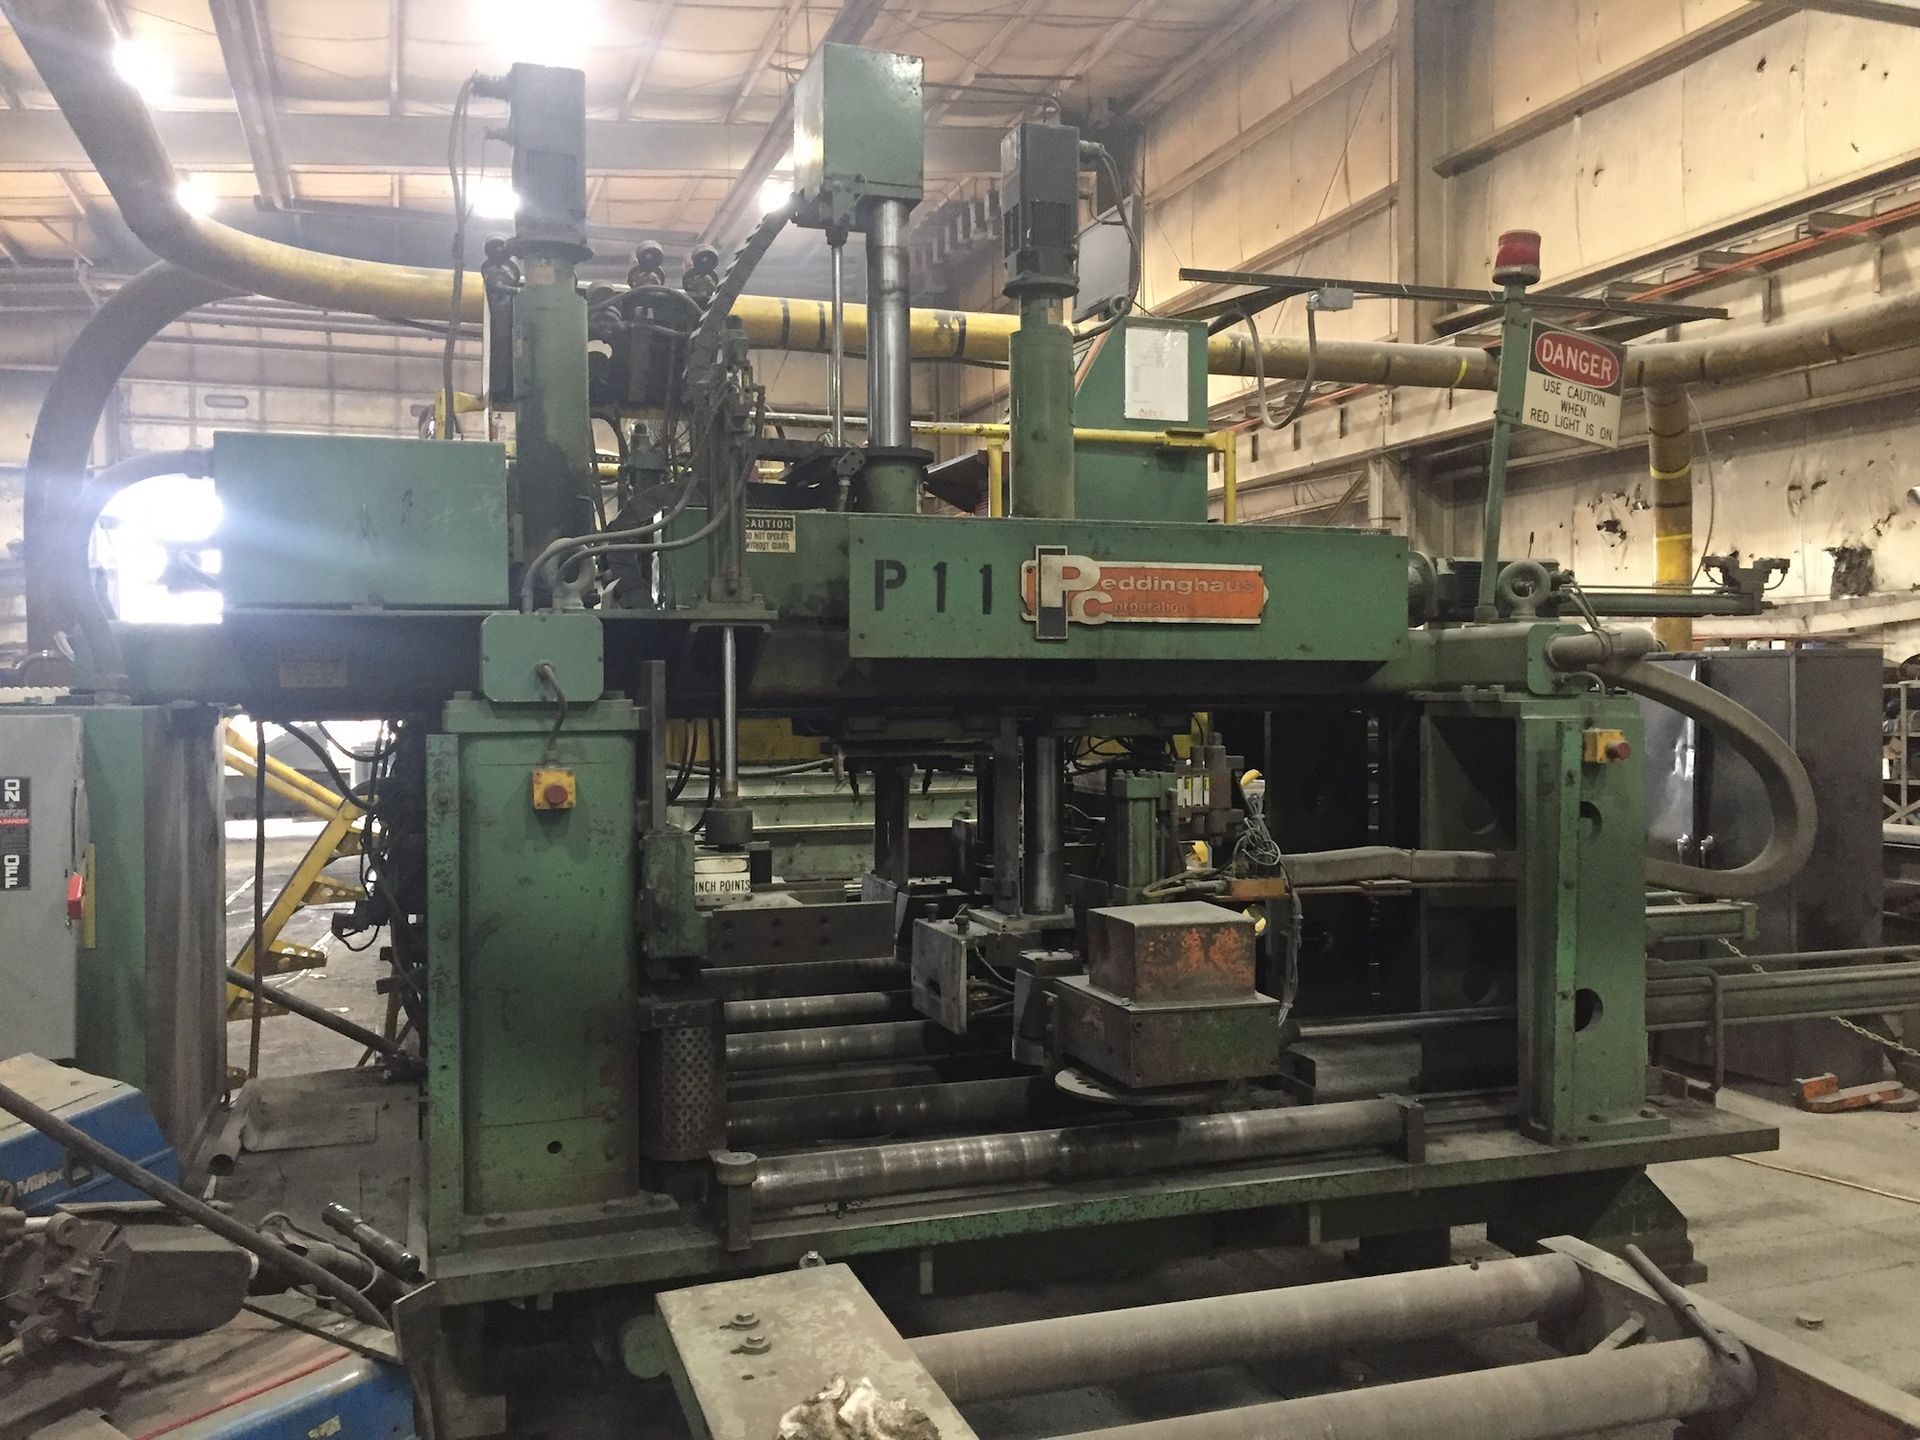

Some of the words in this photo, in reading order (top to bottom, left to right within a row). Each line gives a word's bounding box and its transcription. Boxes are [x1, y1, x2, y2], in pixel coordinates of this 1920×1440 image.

[1541, 339, 1612, 381] DANGER
[1543, 378, 1562, 395] USE
[1567, 385, 1605, 408] CAUTION
[1560, 400, 1587, 418] WHEN
[1530, 408, 1549, 424] RED
[1554, 414, 1580, 432] LIGHT
[1586, 423, 1595, 437] IS
[1600, 427, 1612, 441] ON
[1040, 554, 1257, 608] Peddinghaus
[1070, 590, 1188, 625] Corporation
[4, 778, 21, 802] ON
[3, 854, 20, 889] OFF
[719, 880, 751, 892] POINTS
